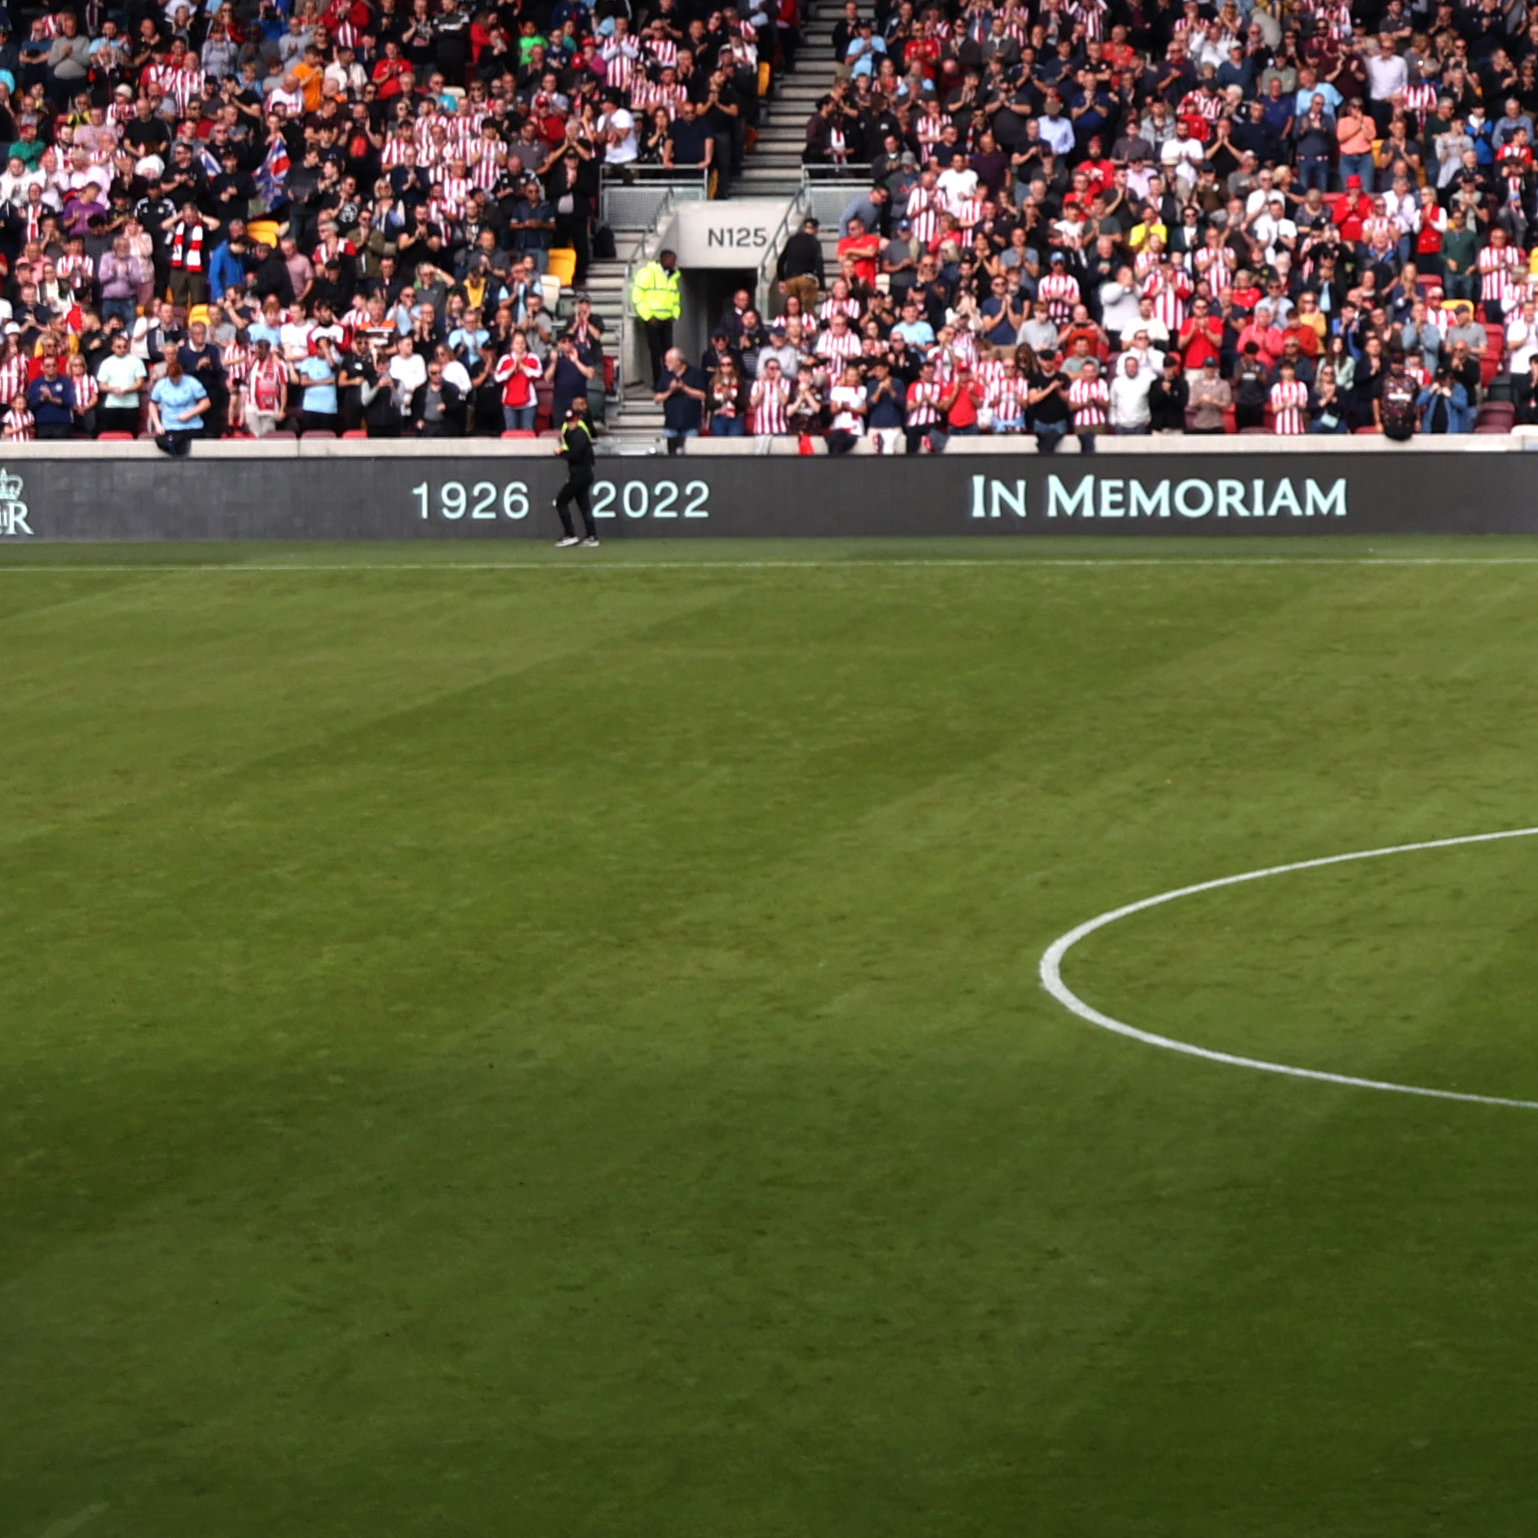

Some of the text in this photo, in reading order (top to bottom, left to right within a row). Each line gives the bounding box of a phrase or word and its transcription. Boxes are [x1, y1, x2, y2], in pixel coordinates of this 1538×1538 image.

[707, 228, 768, 247] N125
[412, 480, 710, 521] 1926 2022
